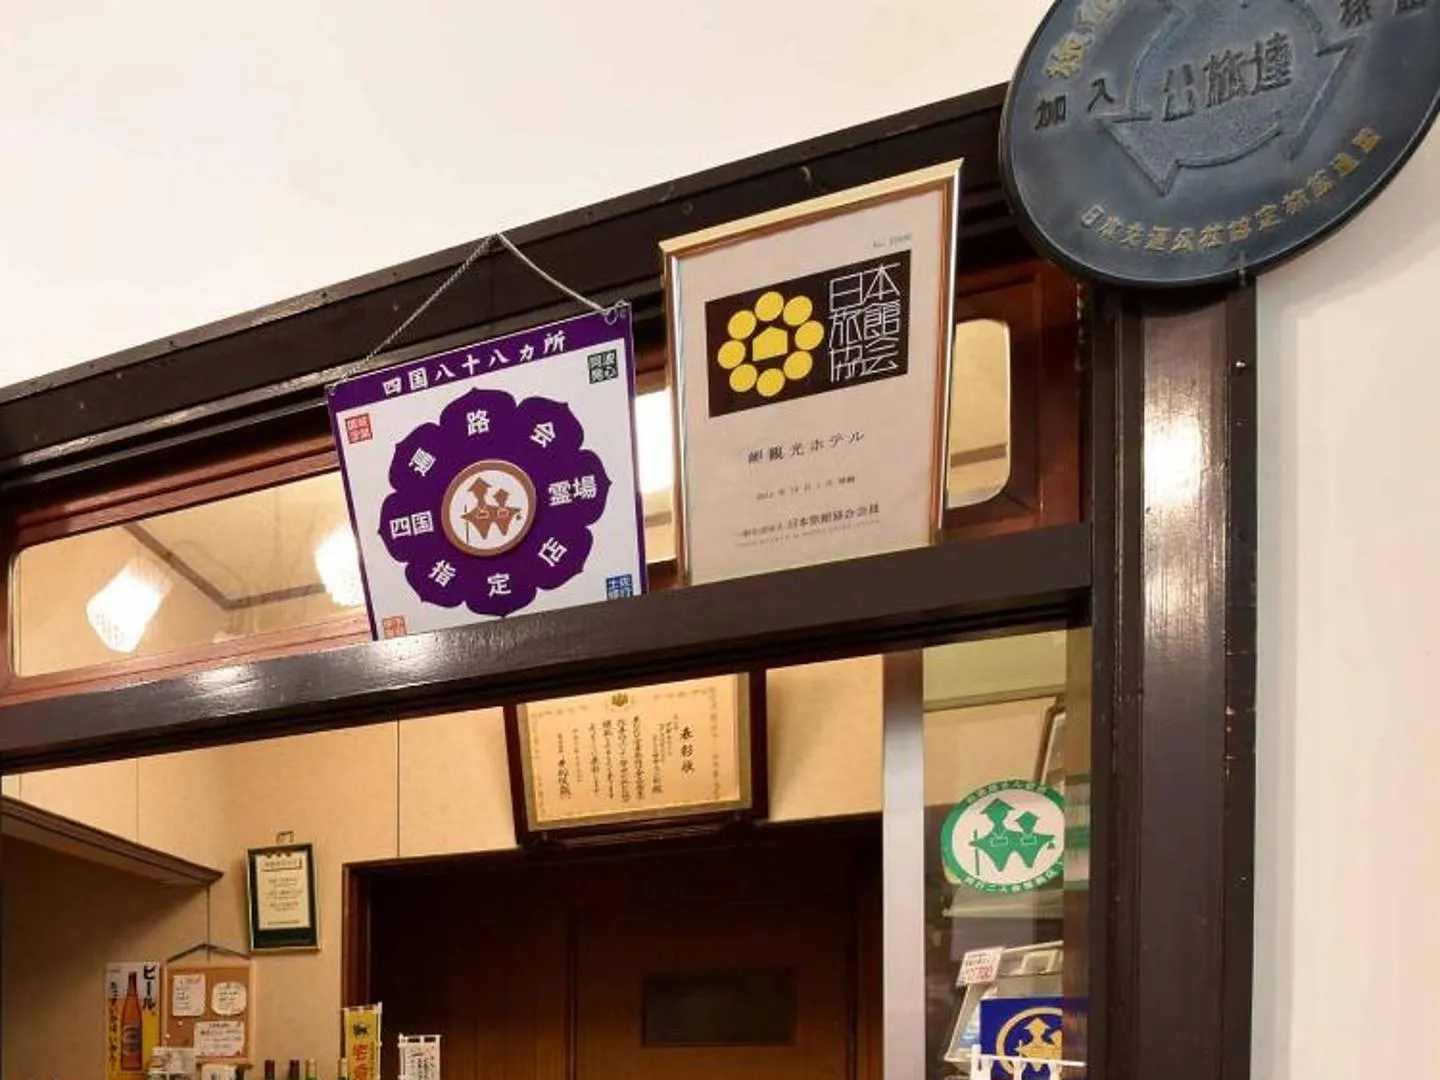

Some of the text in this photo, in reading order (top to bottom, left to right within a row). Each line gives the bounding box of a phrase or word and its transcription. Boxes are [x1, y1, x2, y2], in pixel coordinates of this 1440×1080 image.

[390, 511, 434, 539] 四国
[466, 409, 490, 436] 路
[487, 572, 512, 597] 定
[538, 536, 568, 567] 店
[143, 961, 157, 1011] ビール
